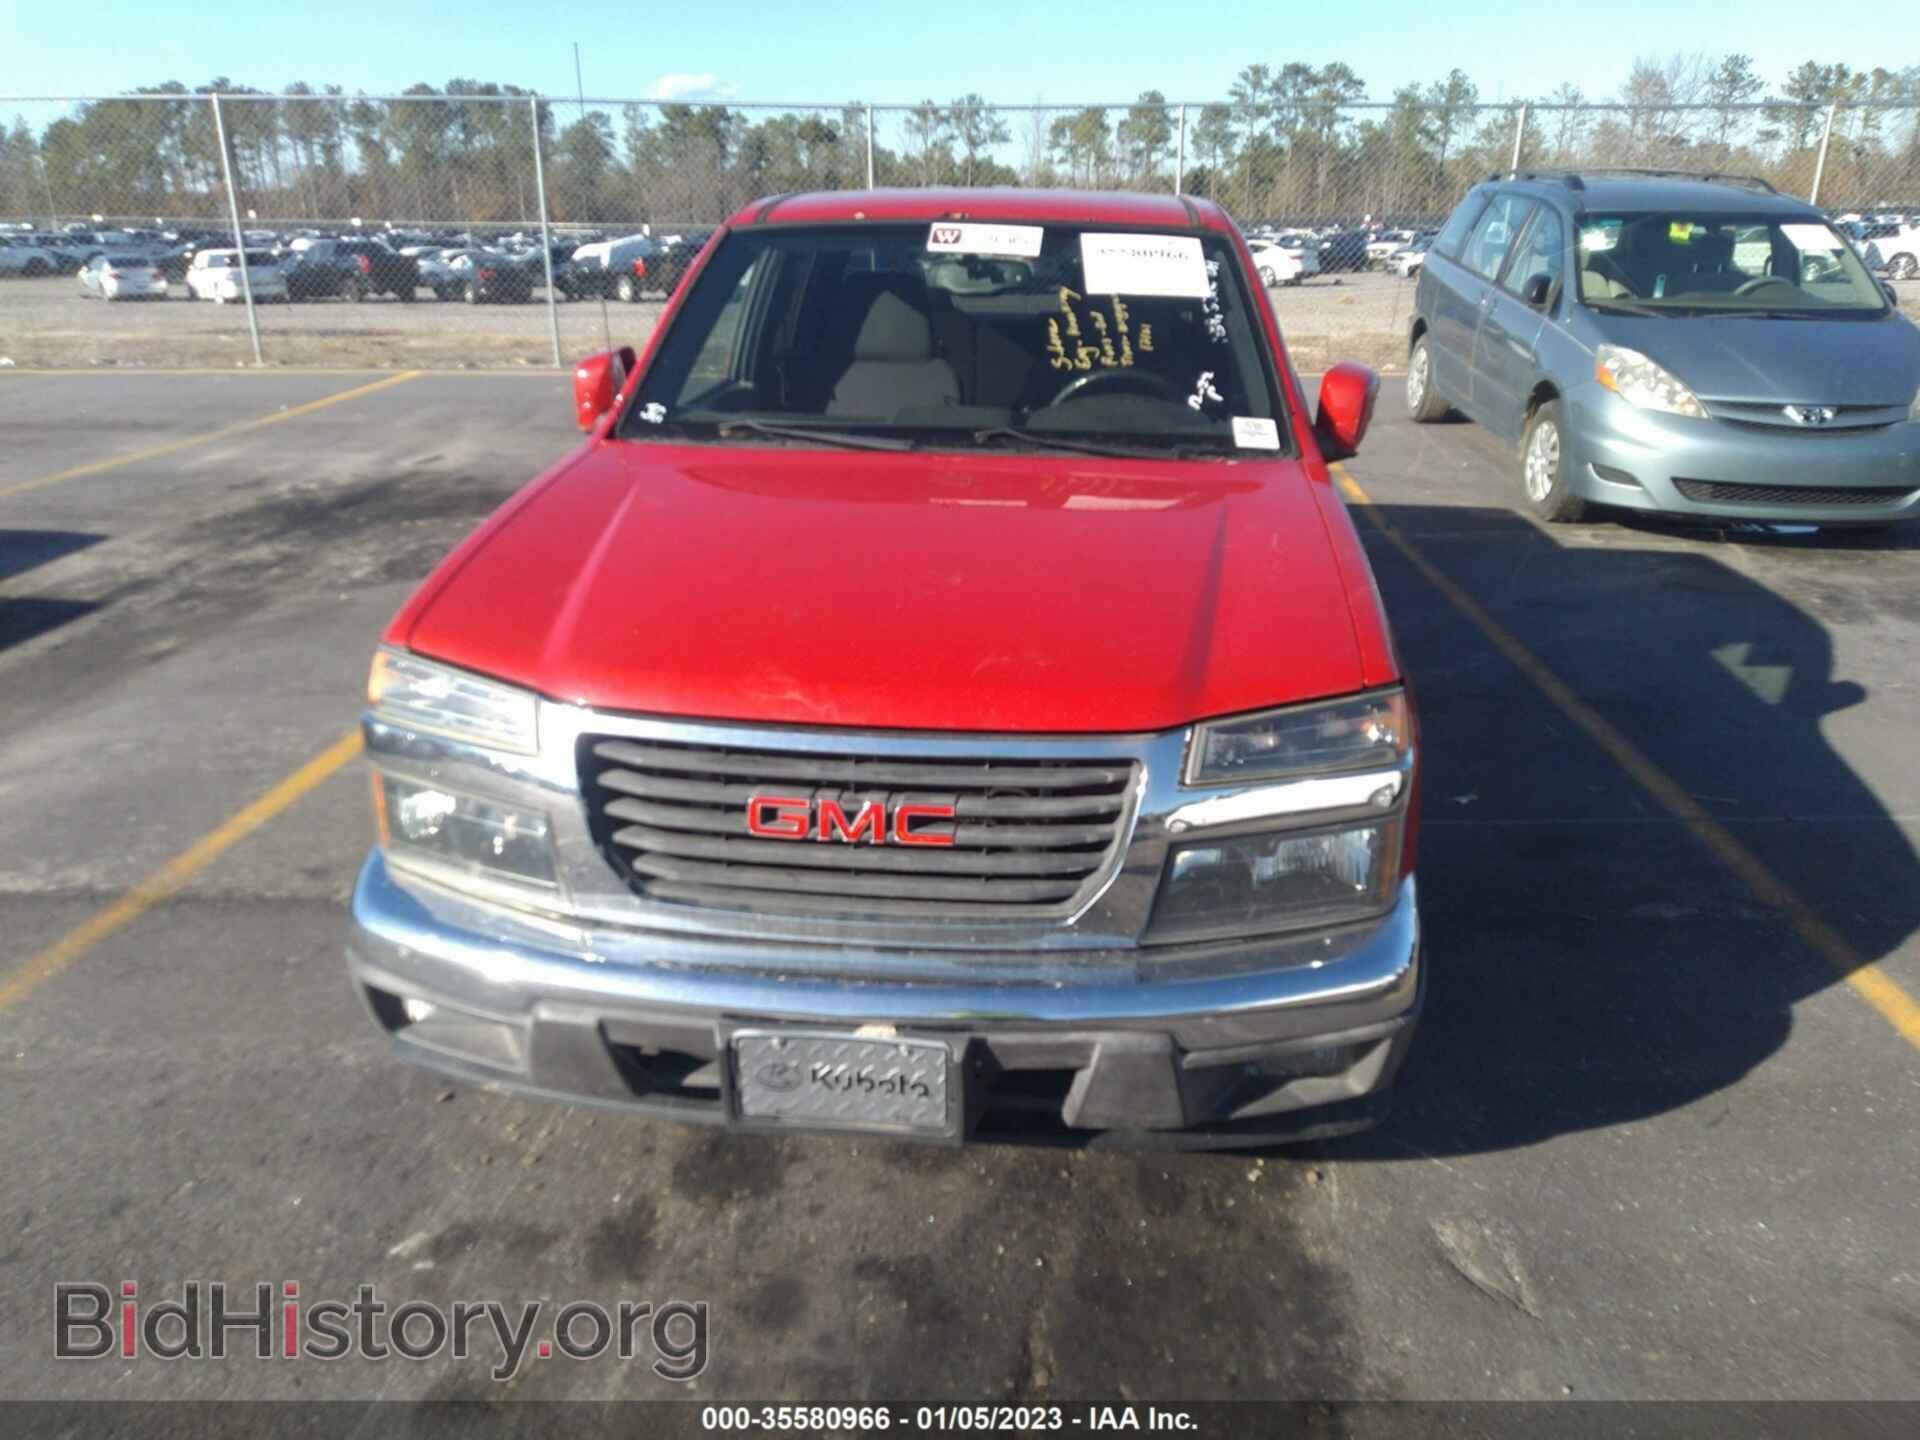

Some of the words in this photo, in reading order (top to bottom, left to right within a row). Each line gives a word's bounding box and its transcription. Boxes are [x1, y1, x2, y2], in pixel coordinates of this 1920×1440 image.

[932, 228, 961, 244] W
[746, 795, 956, 846] GMC
[811, 1063, 930, 1098] Kubota
